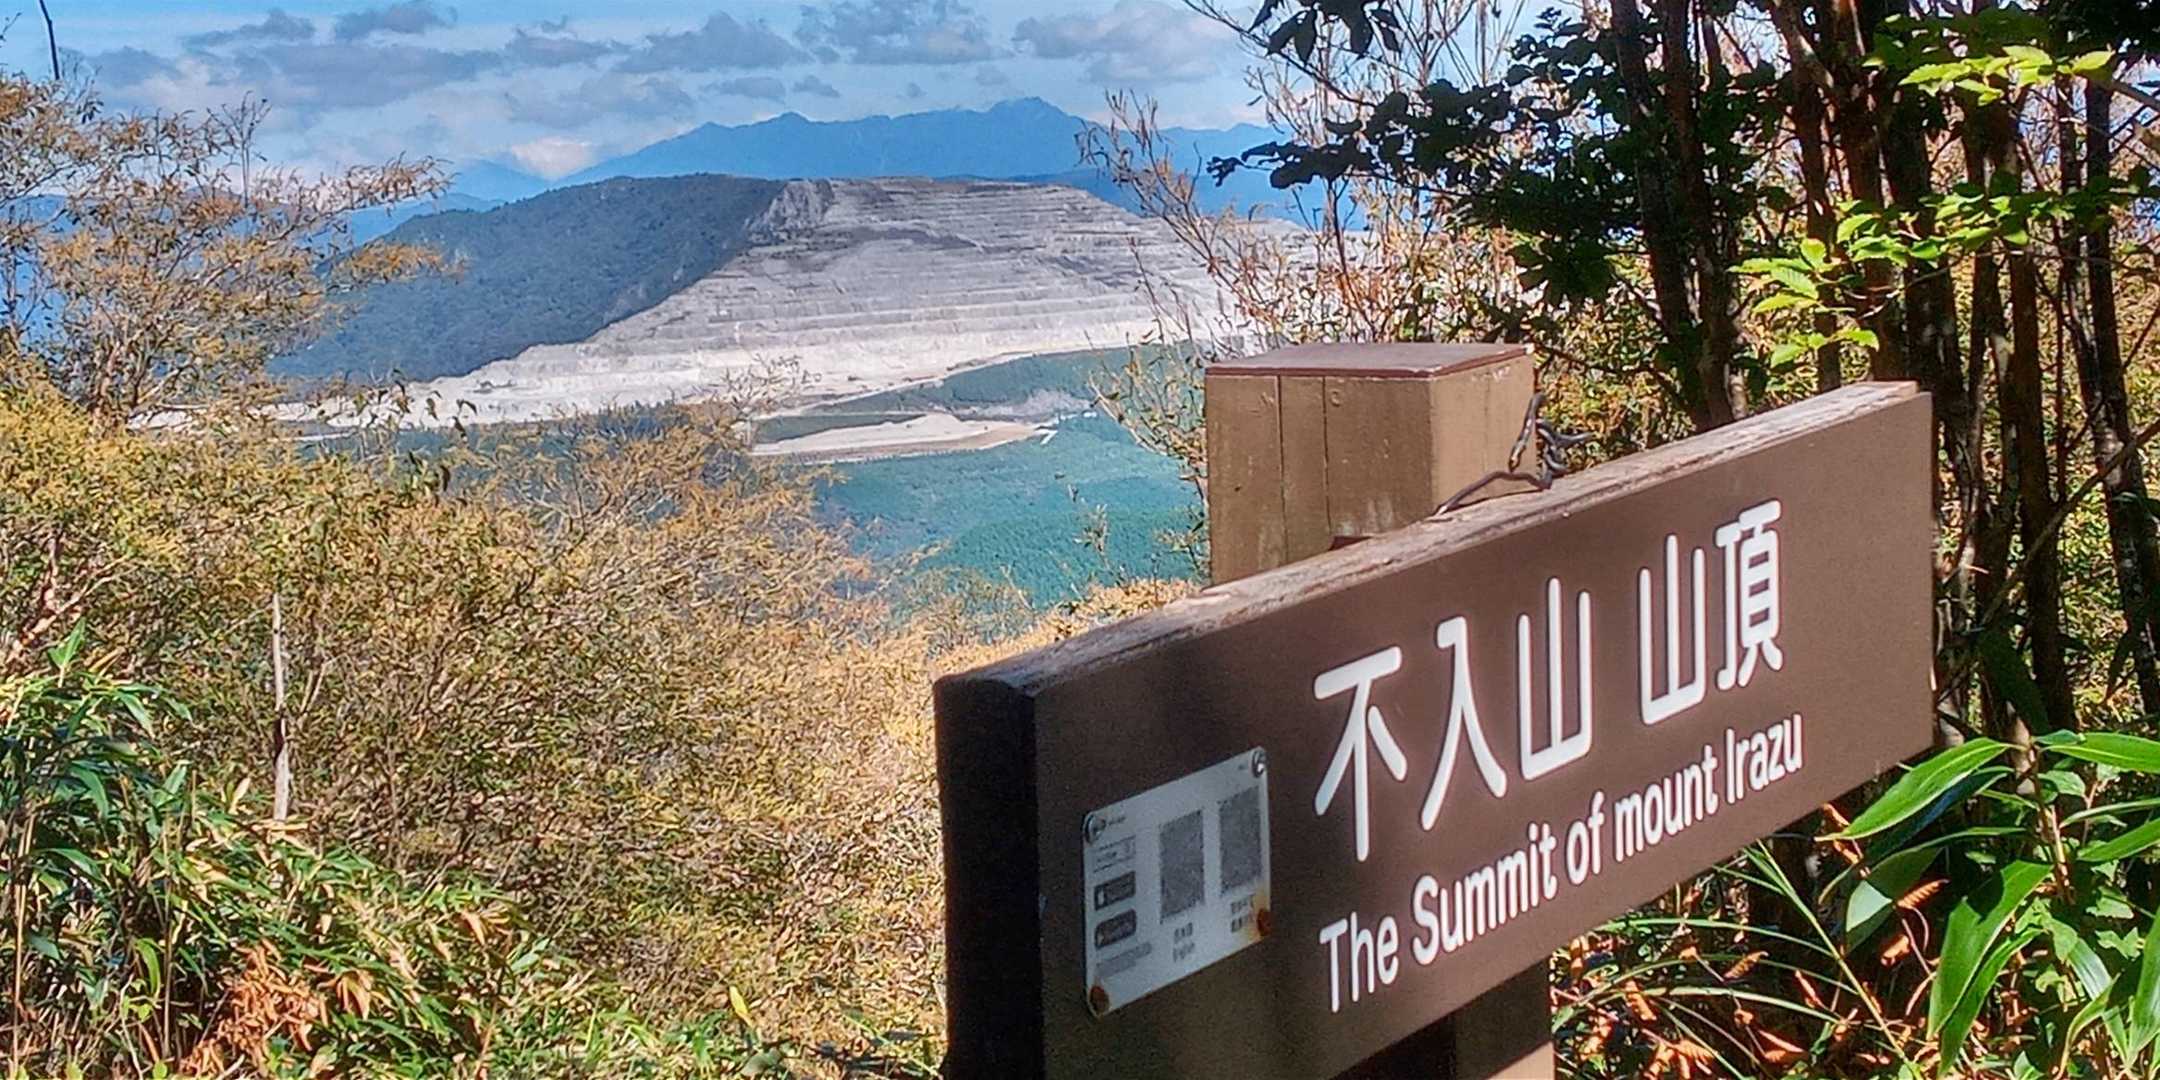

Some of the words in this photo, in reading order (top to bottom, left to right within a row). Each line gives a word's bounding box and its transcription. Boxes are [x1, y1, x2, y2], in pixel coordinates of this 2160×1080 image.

[1313, 577, 1594, 862] 不入山
[1638, 500, 1784, 726] 山頂
[1319, 912, 1399, 1014] The
[1412, 822, 1559, 966] Summit
[1565, 791, 1605, 886] of
[1614, 744, 1719, 863] mount
[1725, 713, 1804, 805] Irazu
